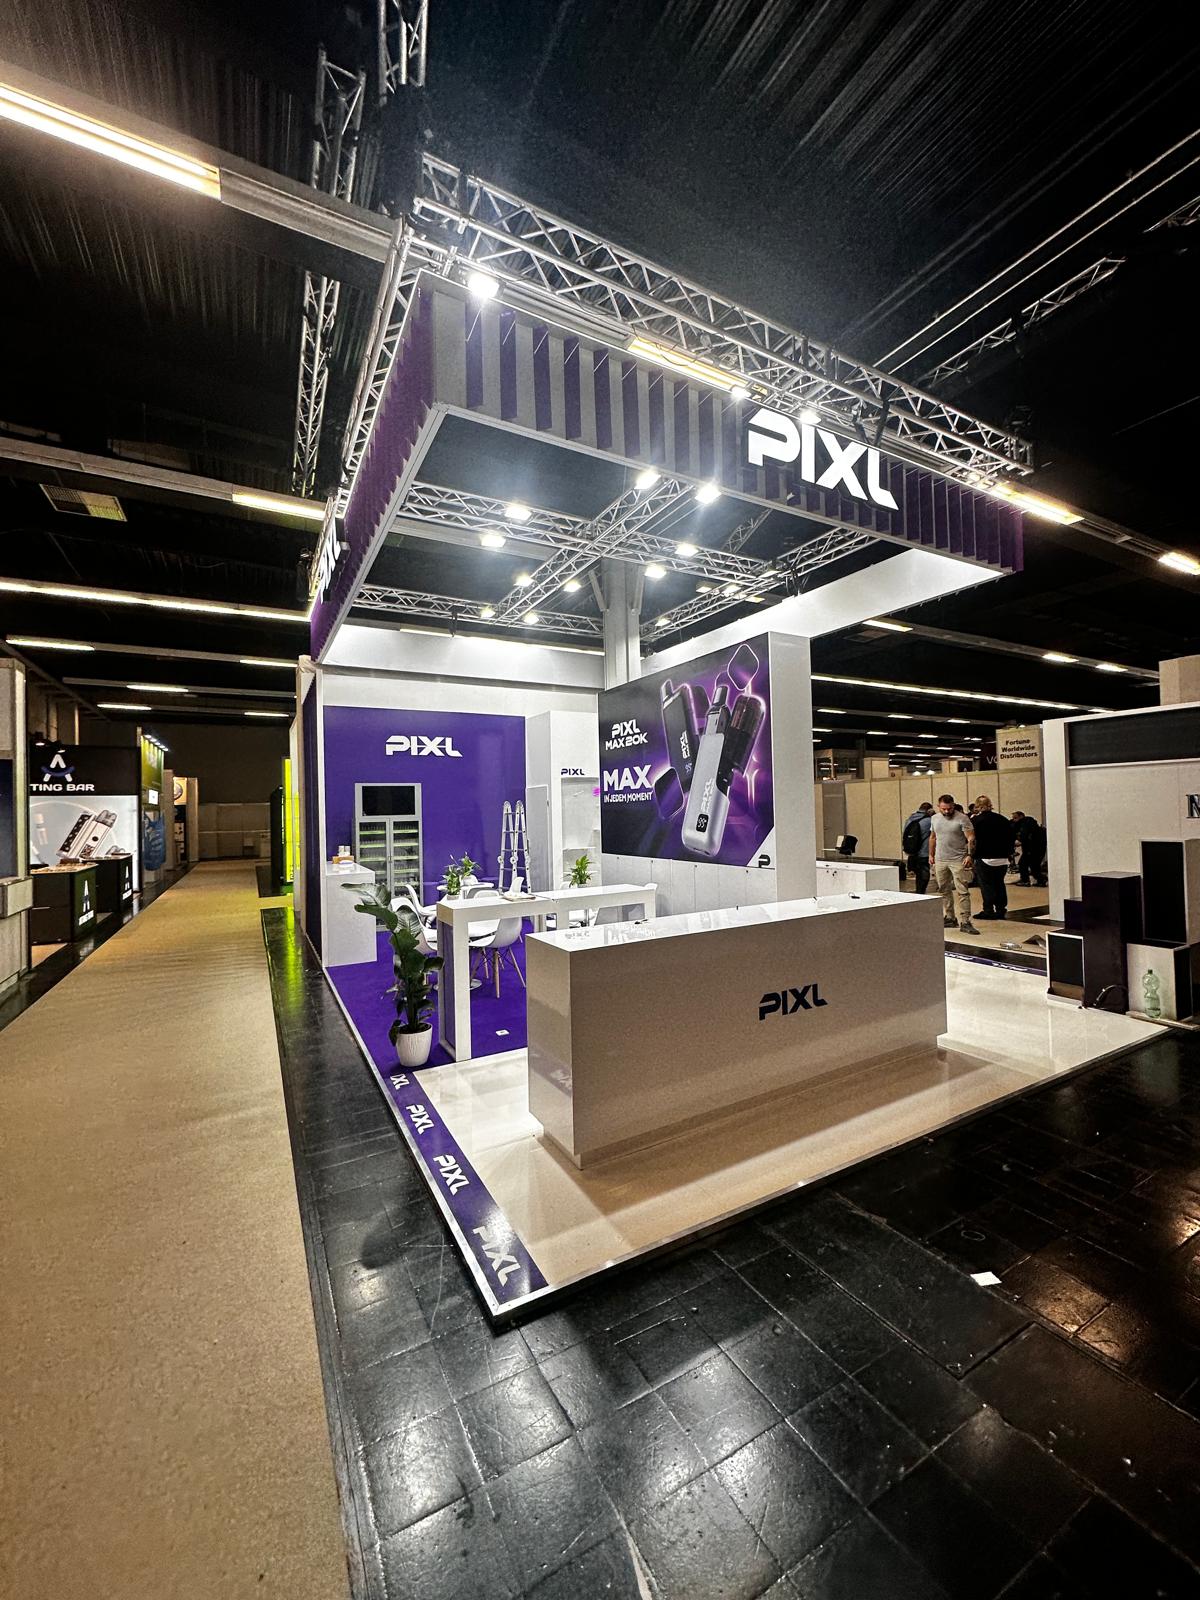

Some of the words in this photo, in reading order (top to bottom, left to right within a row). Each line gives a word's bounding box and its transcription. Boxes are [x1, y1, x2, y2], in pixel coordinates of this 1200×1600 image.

[748, 407, 899, 510] PIXL
[611, 719, 641, 738] PIXL
[385, 735, 463, 758] PIXL
[1000, 752, 1038, 760] Distributors
[1001, 745, 1036, 753] Worldwide
[560, 768, 586, 776] PIXL
[603, 765, 652, 792] MAX
[66, 783, 95, 792] BAR
[627, 791, 653, 803] MOMENT
[758, 983, 828, 1020] PIXL
[405, 1104, 435, 1135] PIXL
[432, 1154, 470, 1196] PIXL
[472, 1224, 521, 1288] PIXL
